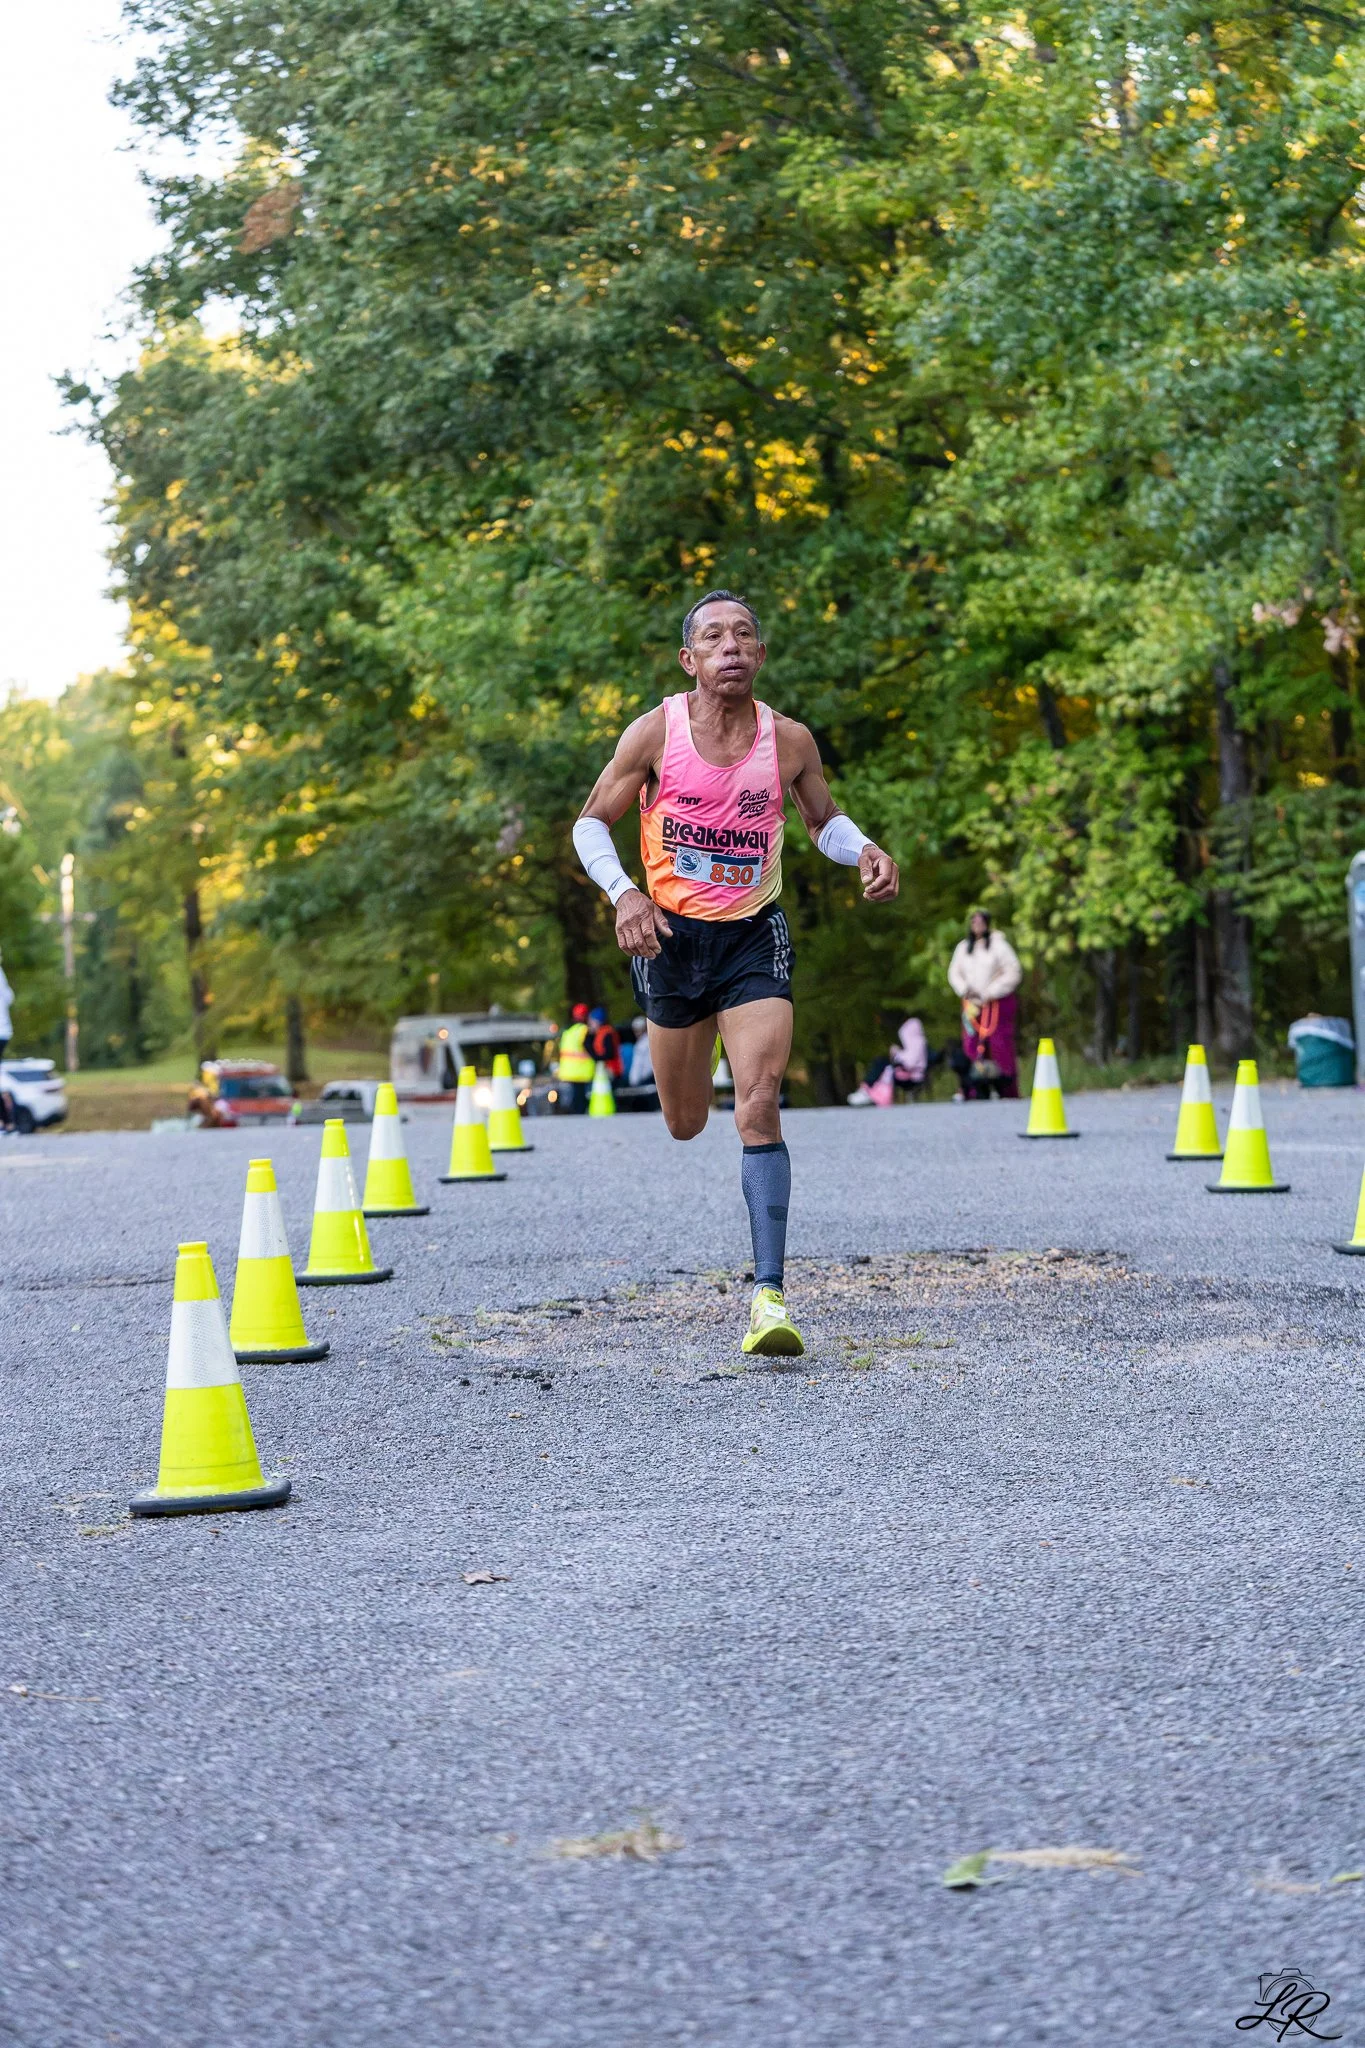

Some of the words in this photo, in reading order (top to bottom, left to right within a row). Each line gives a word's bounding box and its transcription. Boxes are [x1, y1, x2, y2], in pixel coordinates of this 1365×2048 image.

[738, 788, 770, 807] Party
[662, 816, 769, 854] Breakaway
[709, 863, 754, 885] 830
